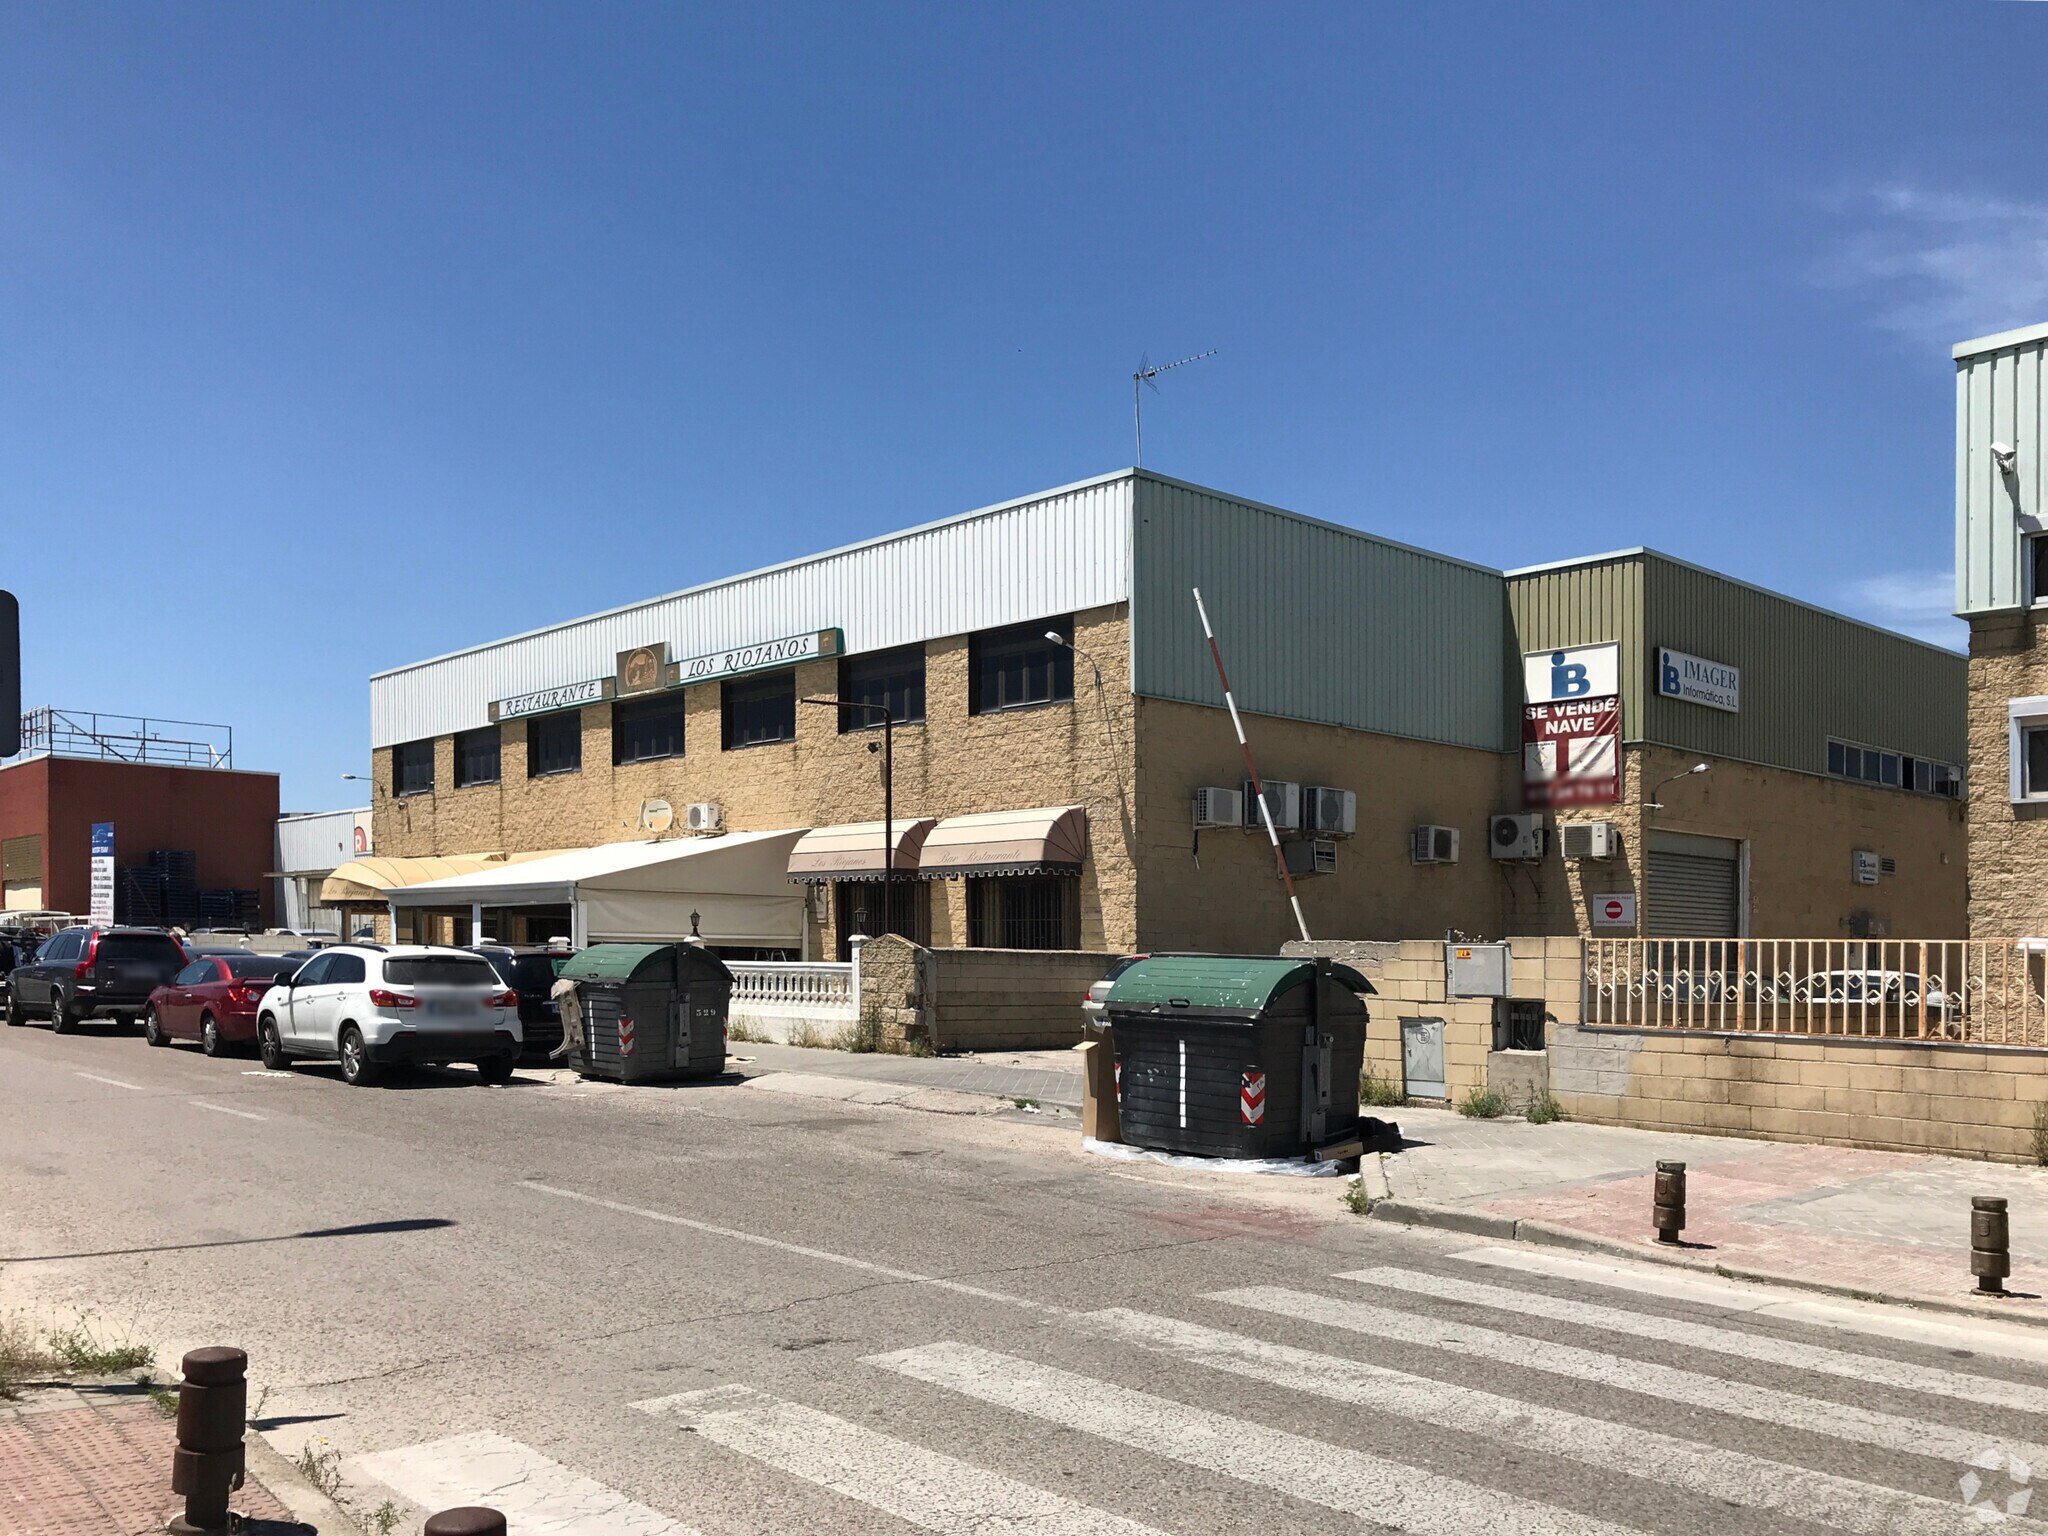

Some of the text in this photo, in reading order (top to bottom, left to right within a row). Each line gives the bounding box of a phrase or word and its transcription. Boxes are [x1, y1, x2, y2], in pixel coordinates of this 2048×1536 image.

[688, 638, 808, 677] LOS RIOJANOS
[1684, 660, 1737, 690] IMAGER
[506, 682, 596, 715] RESTAURANTE
[1683, 684, 1725, 706] Informática,
[1525, 697, 1616, 720] SE VENDE
[1546, 717, 1594, 734] NAVE
[937, 849, 1022, 864] Bar Restaurante
